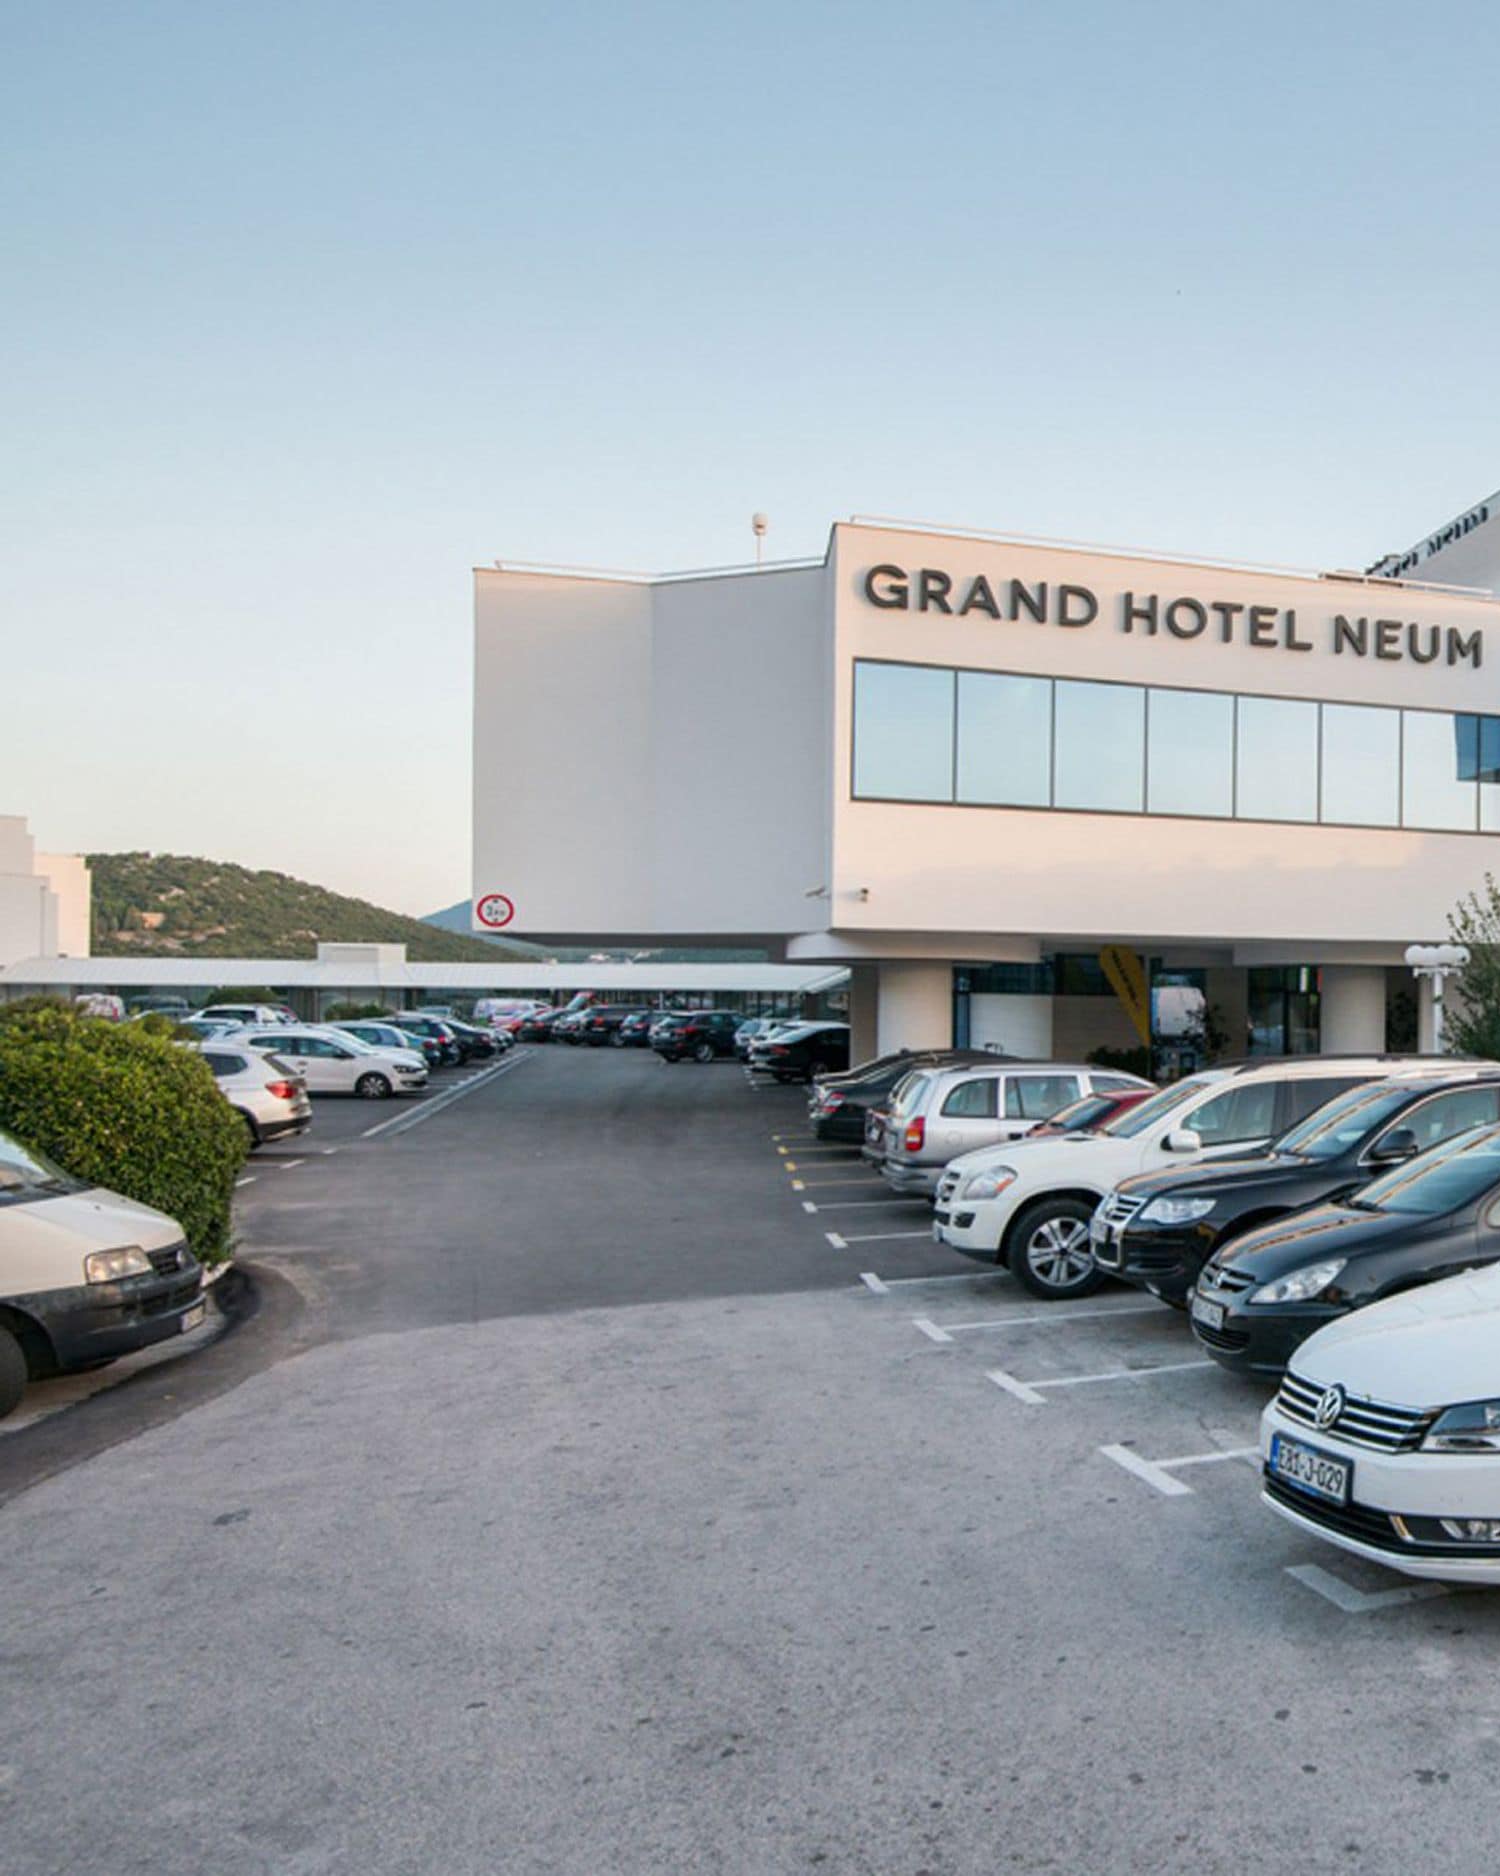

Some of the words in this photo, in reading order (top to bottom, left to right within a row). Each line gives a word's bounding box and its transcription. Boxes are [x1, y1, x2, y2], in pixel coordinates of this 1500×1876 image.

[863, 565, 1098, 628] GRAND
[1122, 592, 1314, 653] HOTEL
[1333, 615, 1483, 669] NEUM
